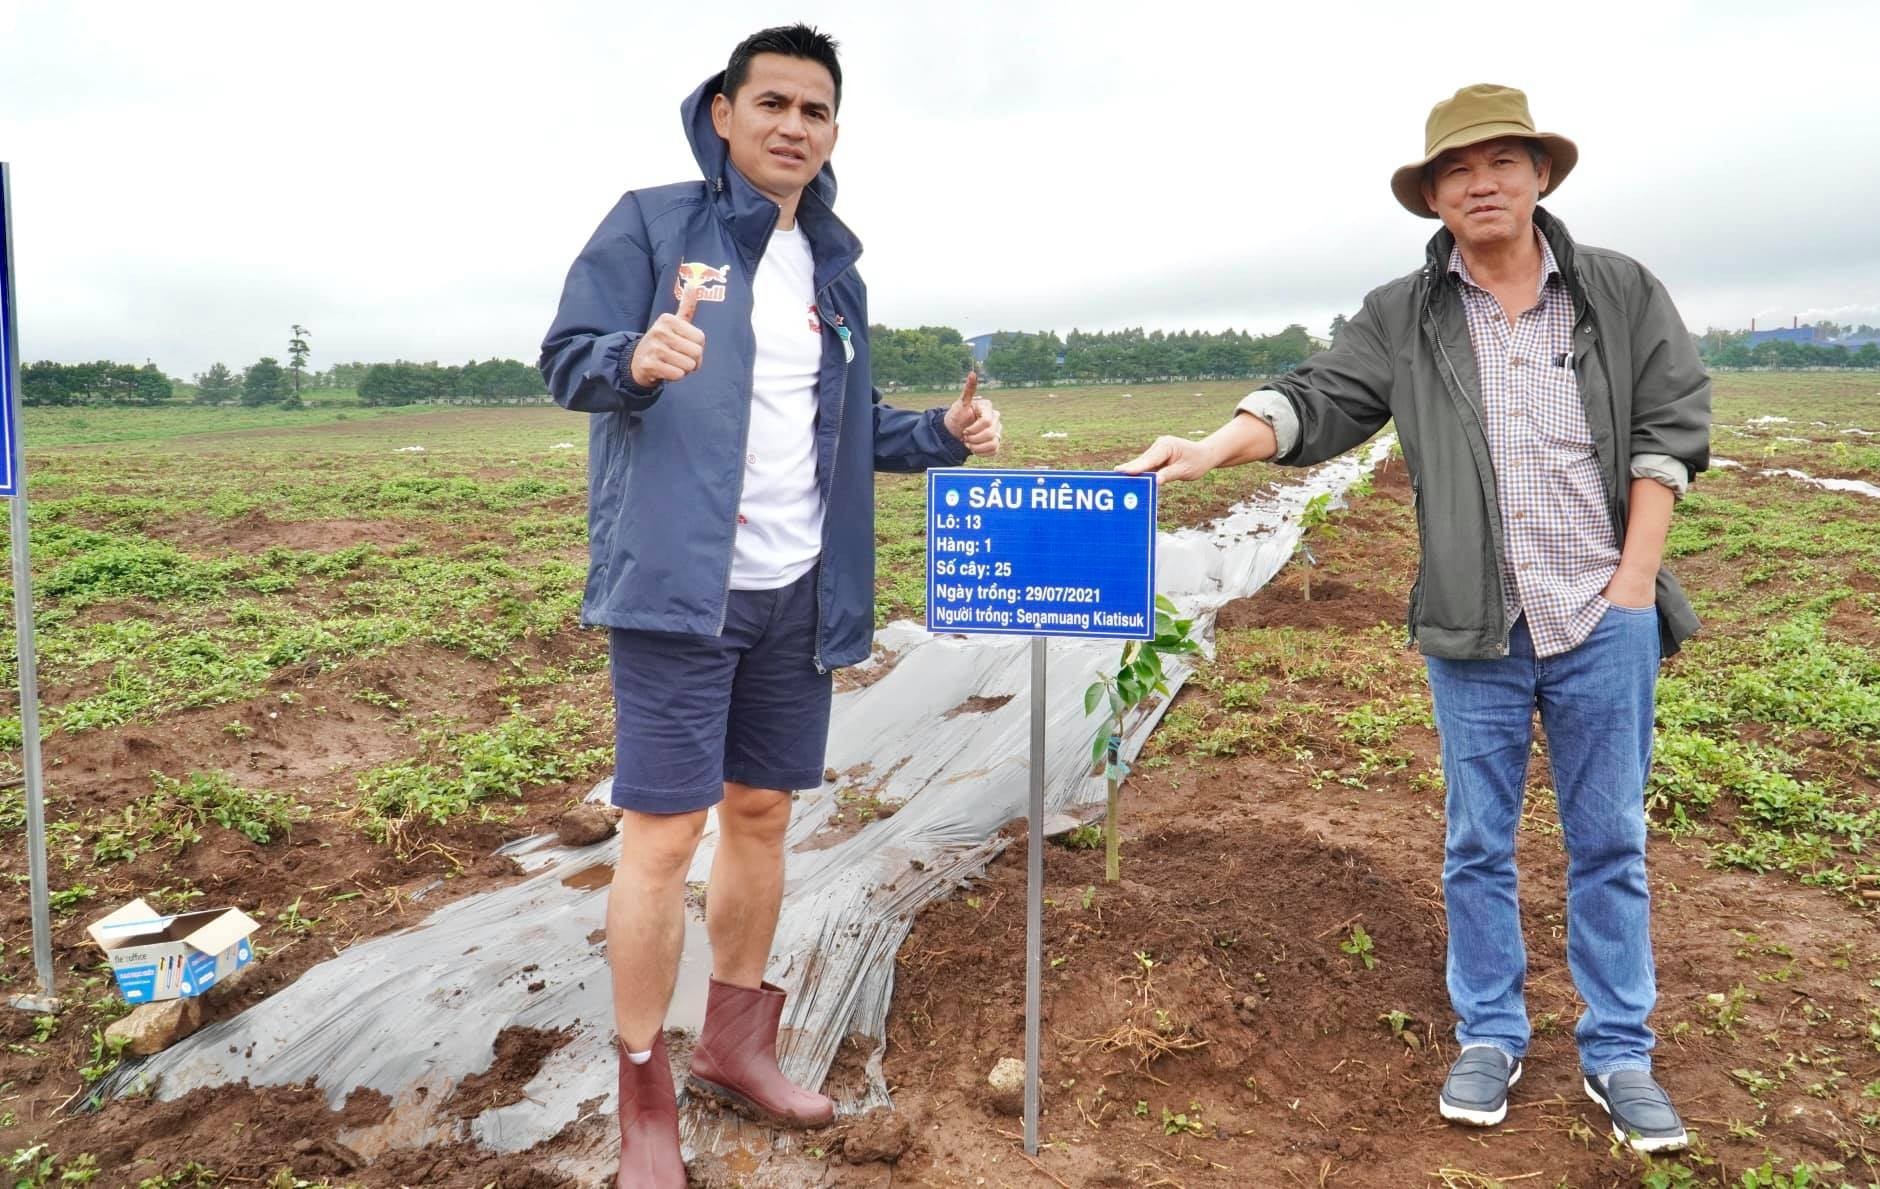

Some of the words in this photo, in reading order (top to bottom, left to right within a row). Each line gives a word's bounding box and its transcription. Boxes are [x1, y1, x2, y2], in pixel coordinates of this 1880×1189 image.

[968, 478, 1023, 510] SẦU
[1031, 483, 1114, 511] RIÊNG
[936, 513, 960, 529] Lô:
[964, 514, 982, 530] 13
[936, 536, 980, 556] Hàng:
[984, 537, 992, 552] 1
[936, 558, 957, 576] Số
[959, 561, 990, 580] cây:
[994, 561, 1012, 577] 25
[936, 583, 974, 603] Ngày
[977, 582, 1021, 604] trồng:
[1025, 586, 1101, 603] 29/07/2021
[936, 606, 973, 625] Người
[975, 605, 1013, 627] trồng:
[1016, 609, 1090, 629] Senamuang
[1093, 611, 1145, 628] Kiatisuk
